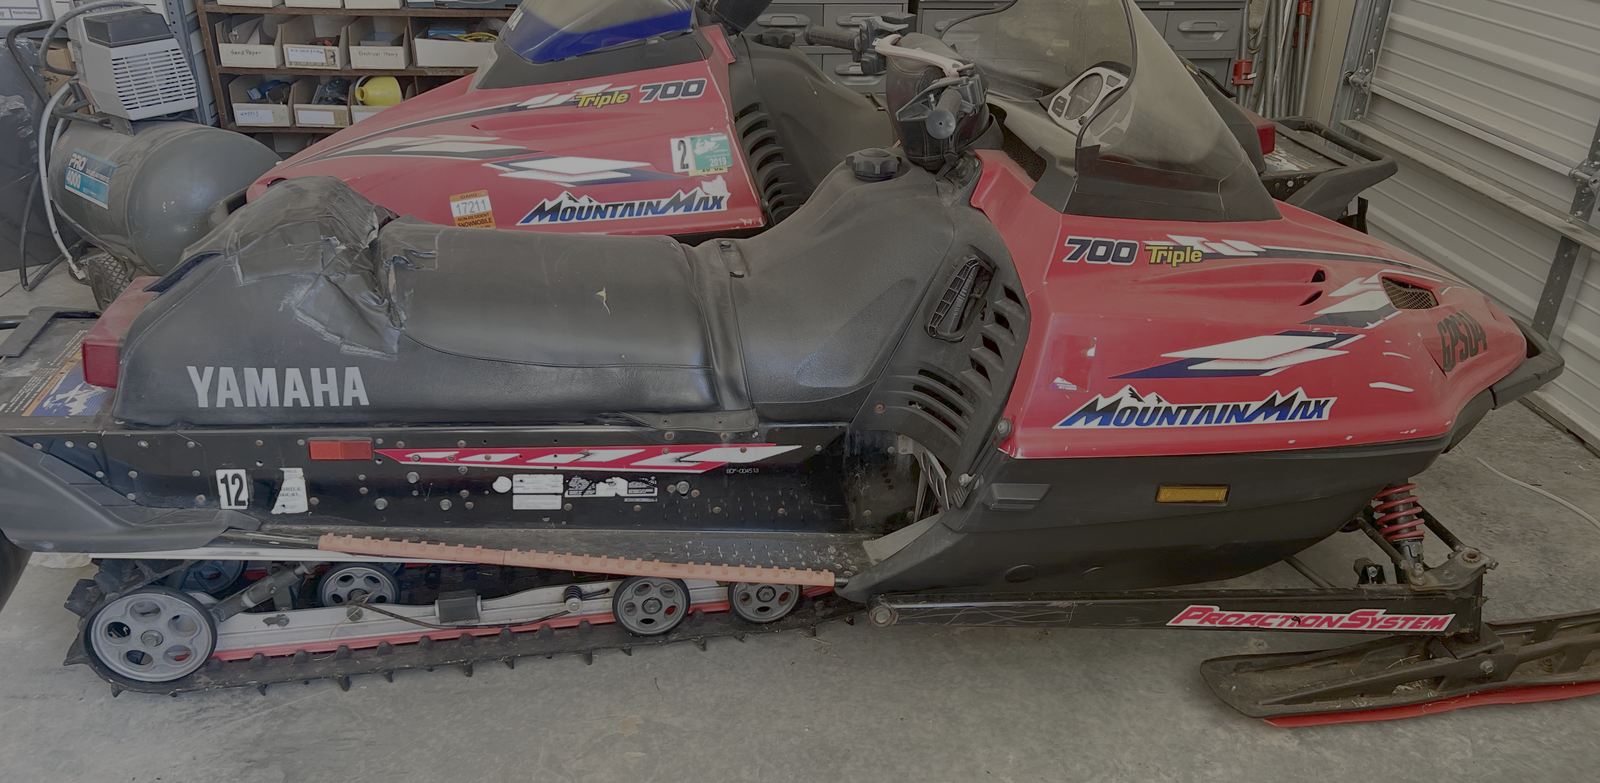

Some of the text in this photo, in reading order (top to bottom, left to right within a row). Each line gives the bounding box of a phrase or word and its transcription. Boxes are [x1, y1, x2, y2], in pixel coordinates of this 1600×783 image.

[575, 78, 707, 108] Triple 700
[68, 152, 87, 172] PRO
[677, 139, 690, 170] 2
[709, 156, 727, 167] 2019
[66, 169, 82, 189] 4000
[459, 192, 478, 200] IDAHO
[455, 199, 487, 215] 17211
[457, 217, 493, 228] SNOWMOBILE
[1064, 236, 1204, 267] 700 Triple
[186, 365, 370, 408] YAMAHA
[219, 472, 247, 507] 12
